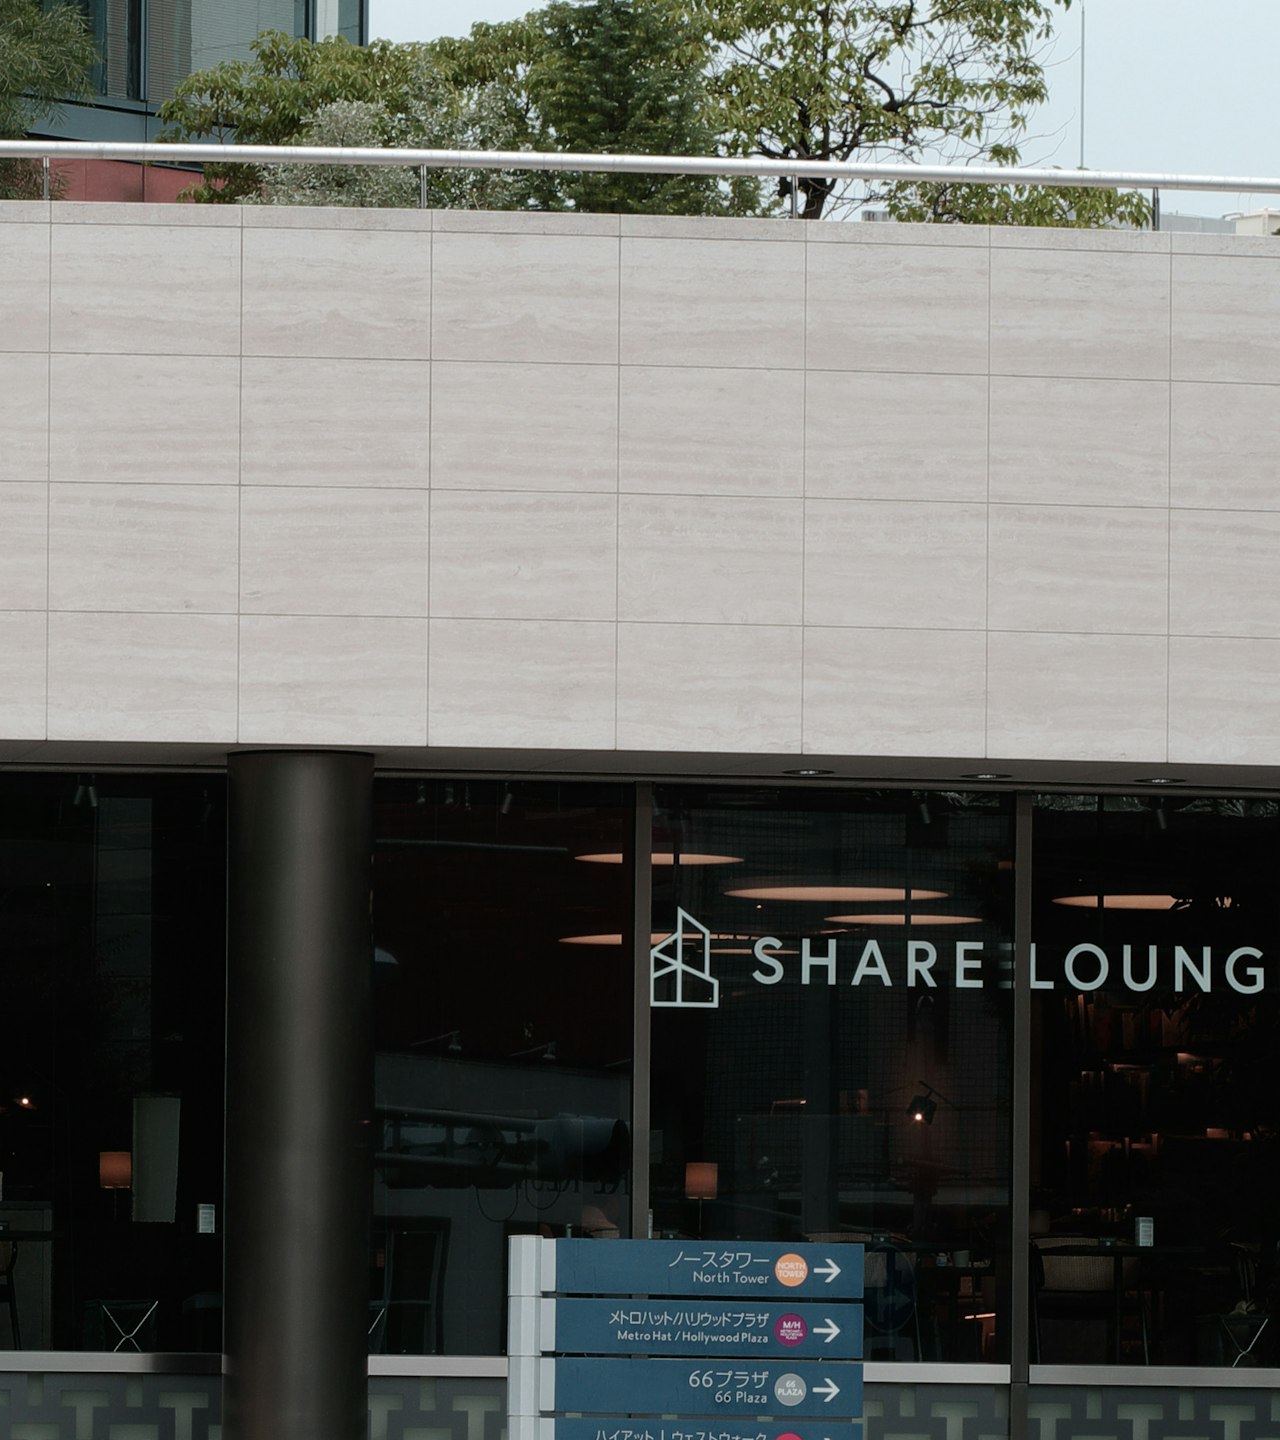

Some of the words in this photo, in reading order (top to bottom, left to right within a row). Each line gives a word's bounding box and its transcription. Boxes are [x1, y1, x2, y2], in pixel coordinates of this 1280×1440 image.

[752, 936, 984, 989] SHARE
[668, 1251, 770, 1268] ノースタワー
[777, 1262, 806, 1270] NORTH
[693, 1271, 730, 1284] North
[733, 1272, 770, 1284] Tower
[778, 1270, 805, 1278] TOWER
[609, 1310, 770, 1328] メトロハット/ハリウッドプラザ
[783, 1321, 801, 1329] M/H
[617, 1330, 650, 1342] Metro
[652, 1331, 672, 1342] Hat
[682, 1331, 740, 1345] Hollywood
[741, 1332, 769, 1344] Plaza
[689, 1370, 769, 1388] 66プラザ
[715, 1391, 732, 1403] 66
[736, 1391, 768, 1404] Plaza
[777, 1388, 803, 1396] PLAZA
